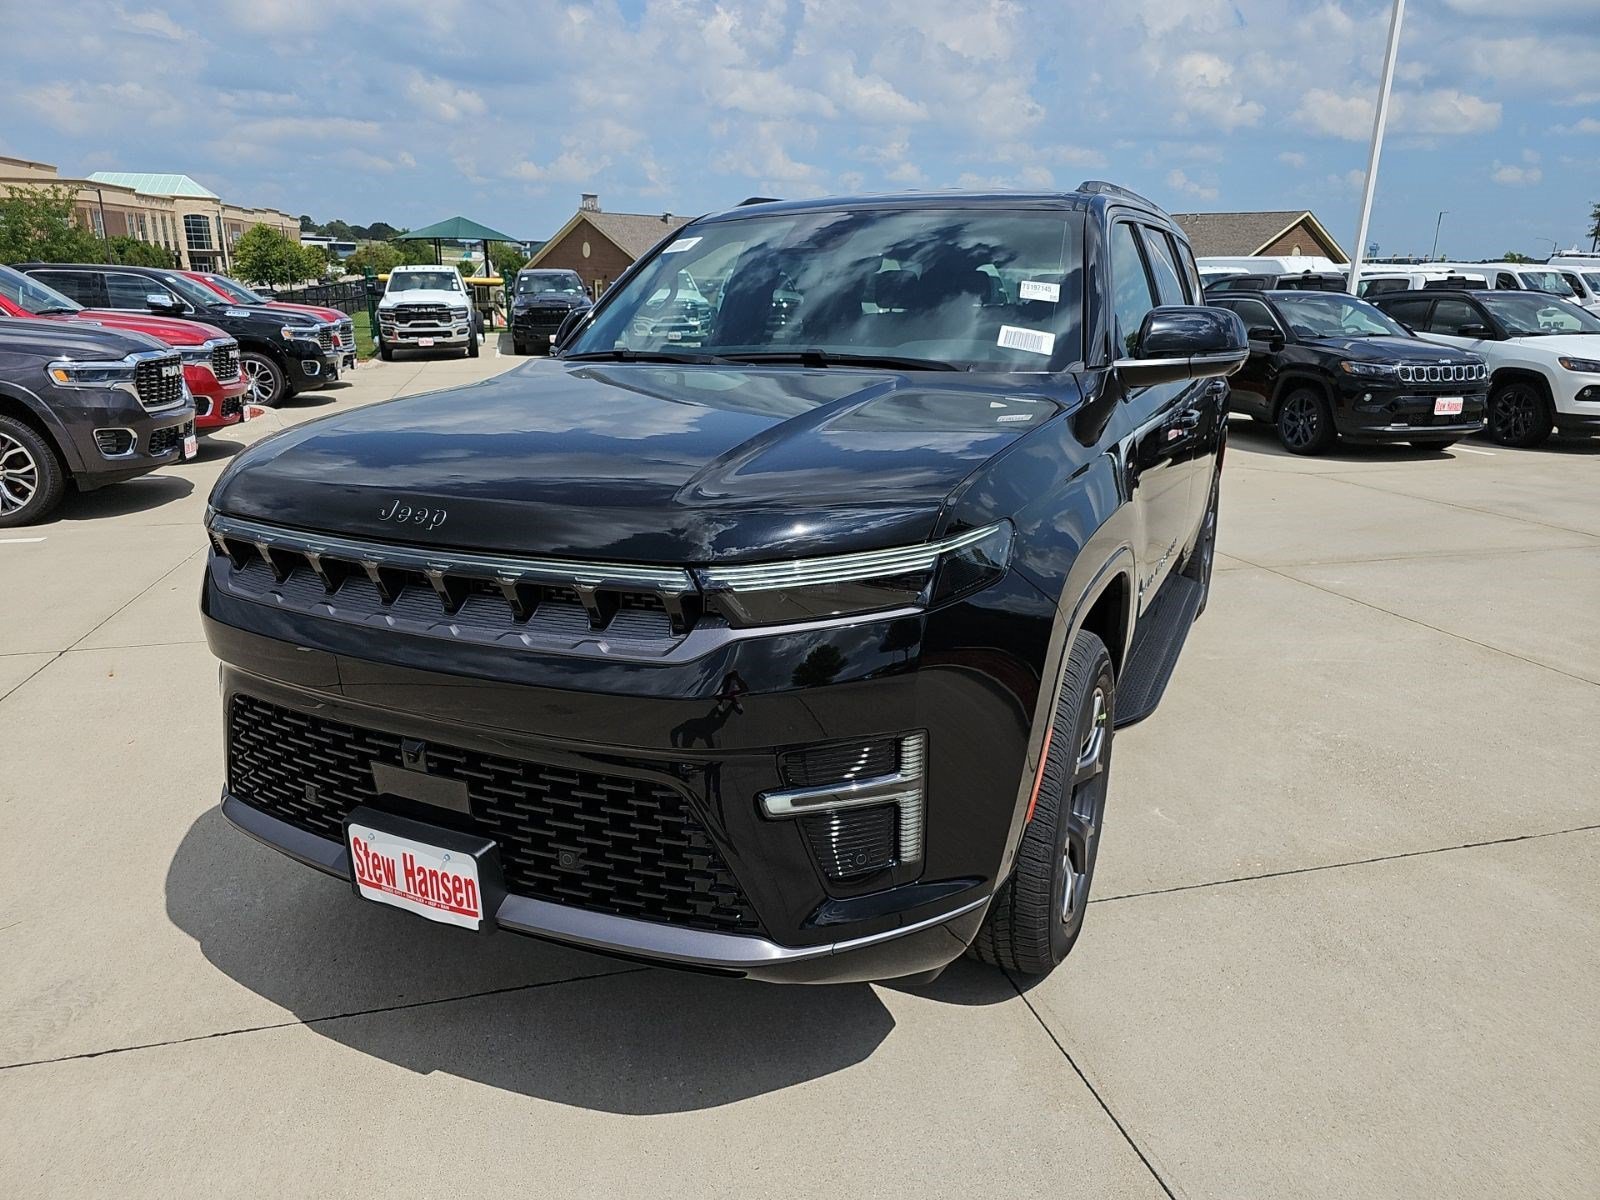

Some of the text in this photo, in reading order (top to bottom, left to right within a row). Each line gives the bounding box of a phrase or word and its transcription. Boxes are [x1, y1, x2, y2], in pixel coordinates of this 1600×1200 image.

[379, 500, 447, 530] Jeep
[352, 837, 478, 910] Stew Hansen
